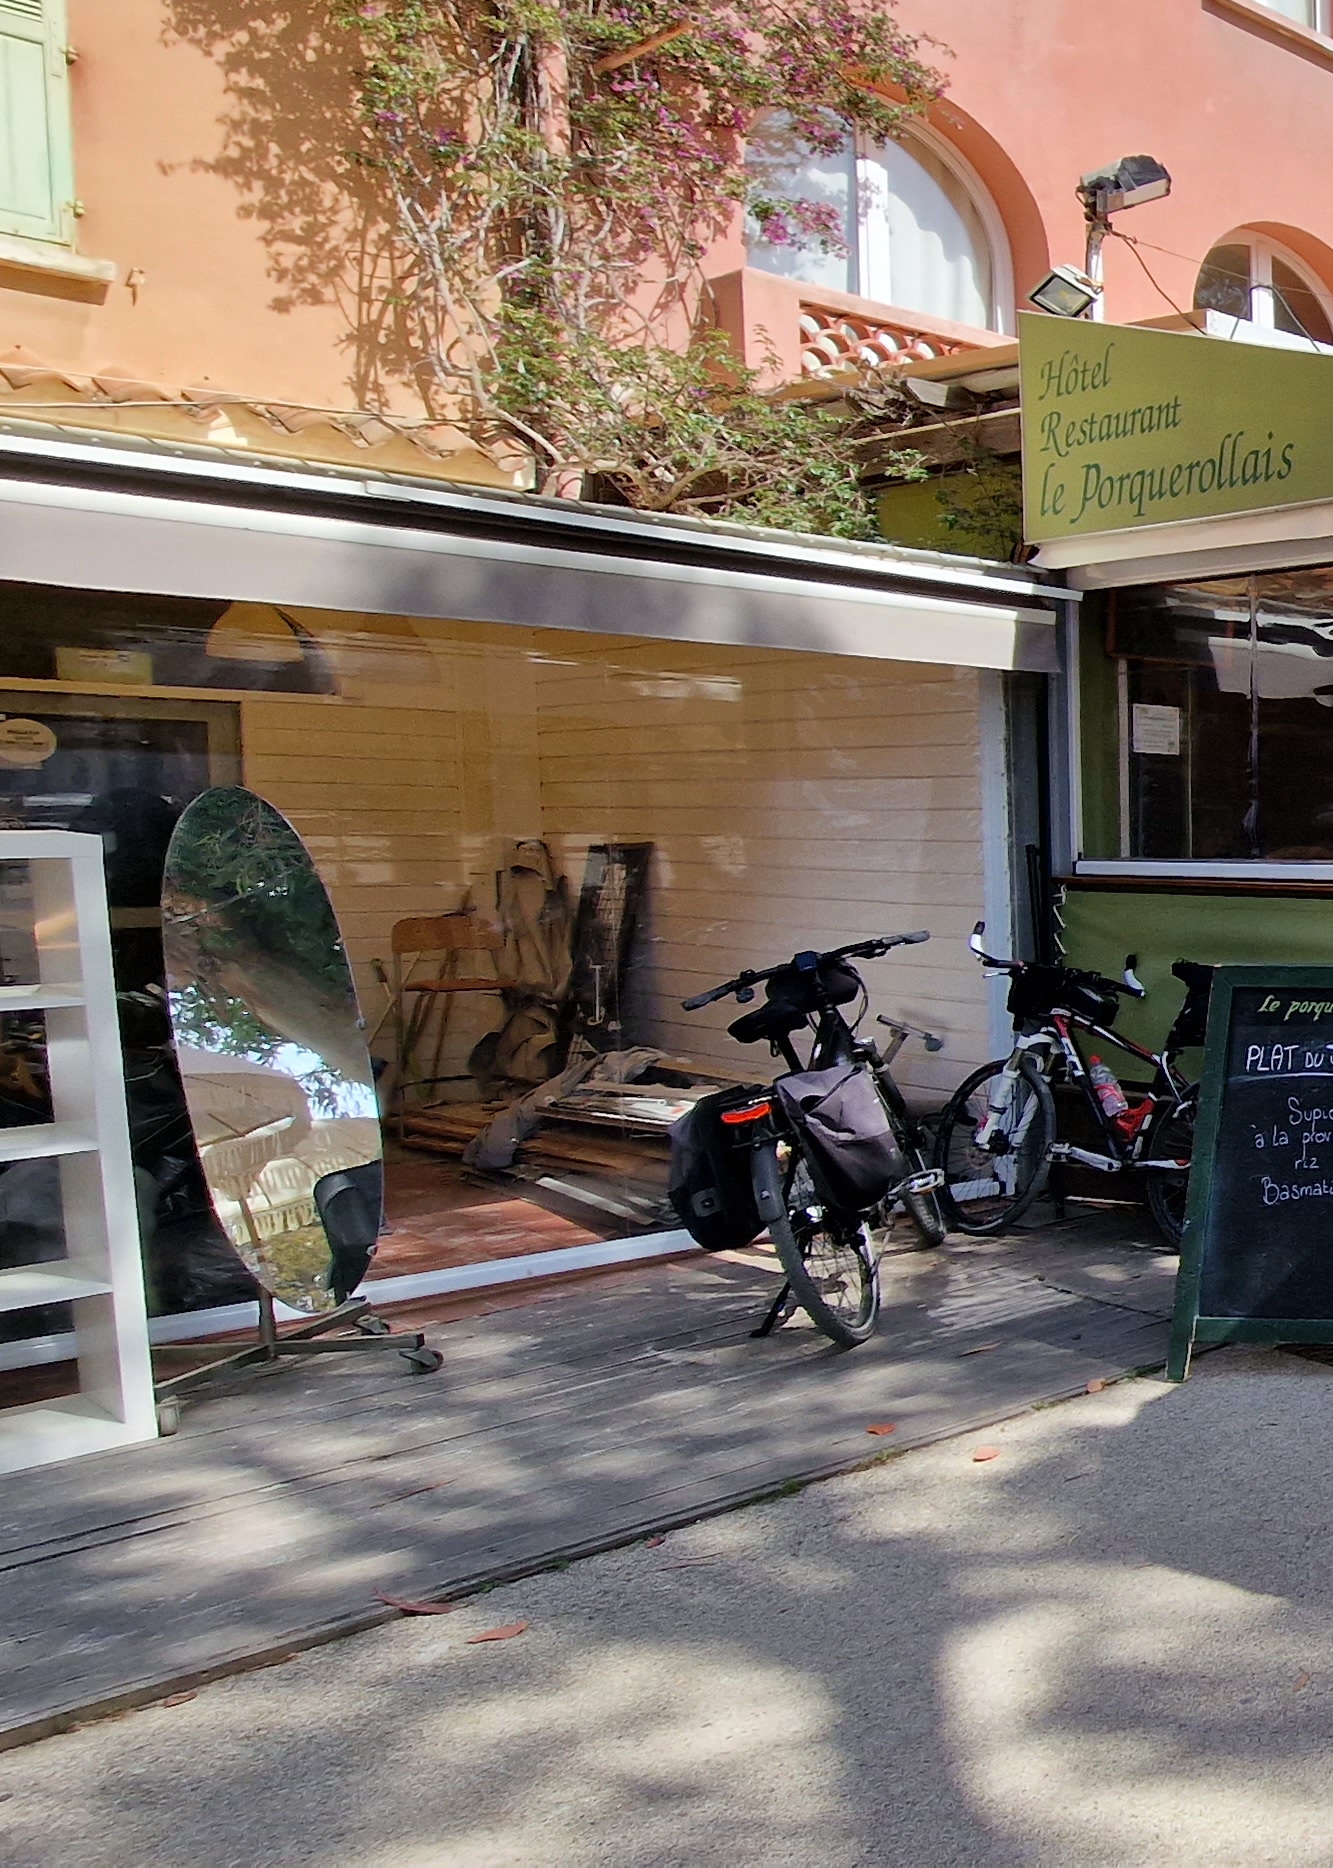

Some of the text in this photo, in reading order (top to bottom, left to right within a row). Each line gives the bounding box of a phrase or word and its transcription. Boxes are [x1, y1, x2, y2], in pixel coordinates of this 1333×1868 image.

[1039, 342, 1117, 401] Hôtel
[1040, 394, 1183, 458] Restaurant
[1040, 462, 1066, 518] le
[1257, 994, 1282, 1013] Le
[1246, 1043, 1301, 1073] PLAT
[1304, 1051, 1326, 1069] DU
[1250, 1124, 1265, 1148] à
[1272, 1124, 1290, 1147] la
[1294, 1156, 1320, 1170] riz
